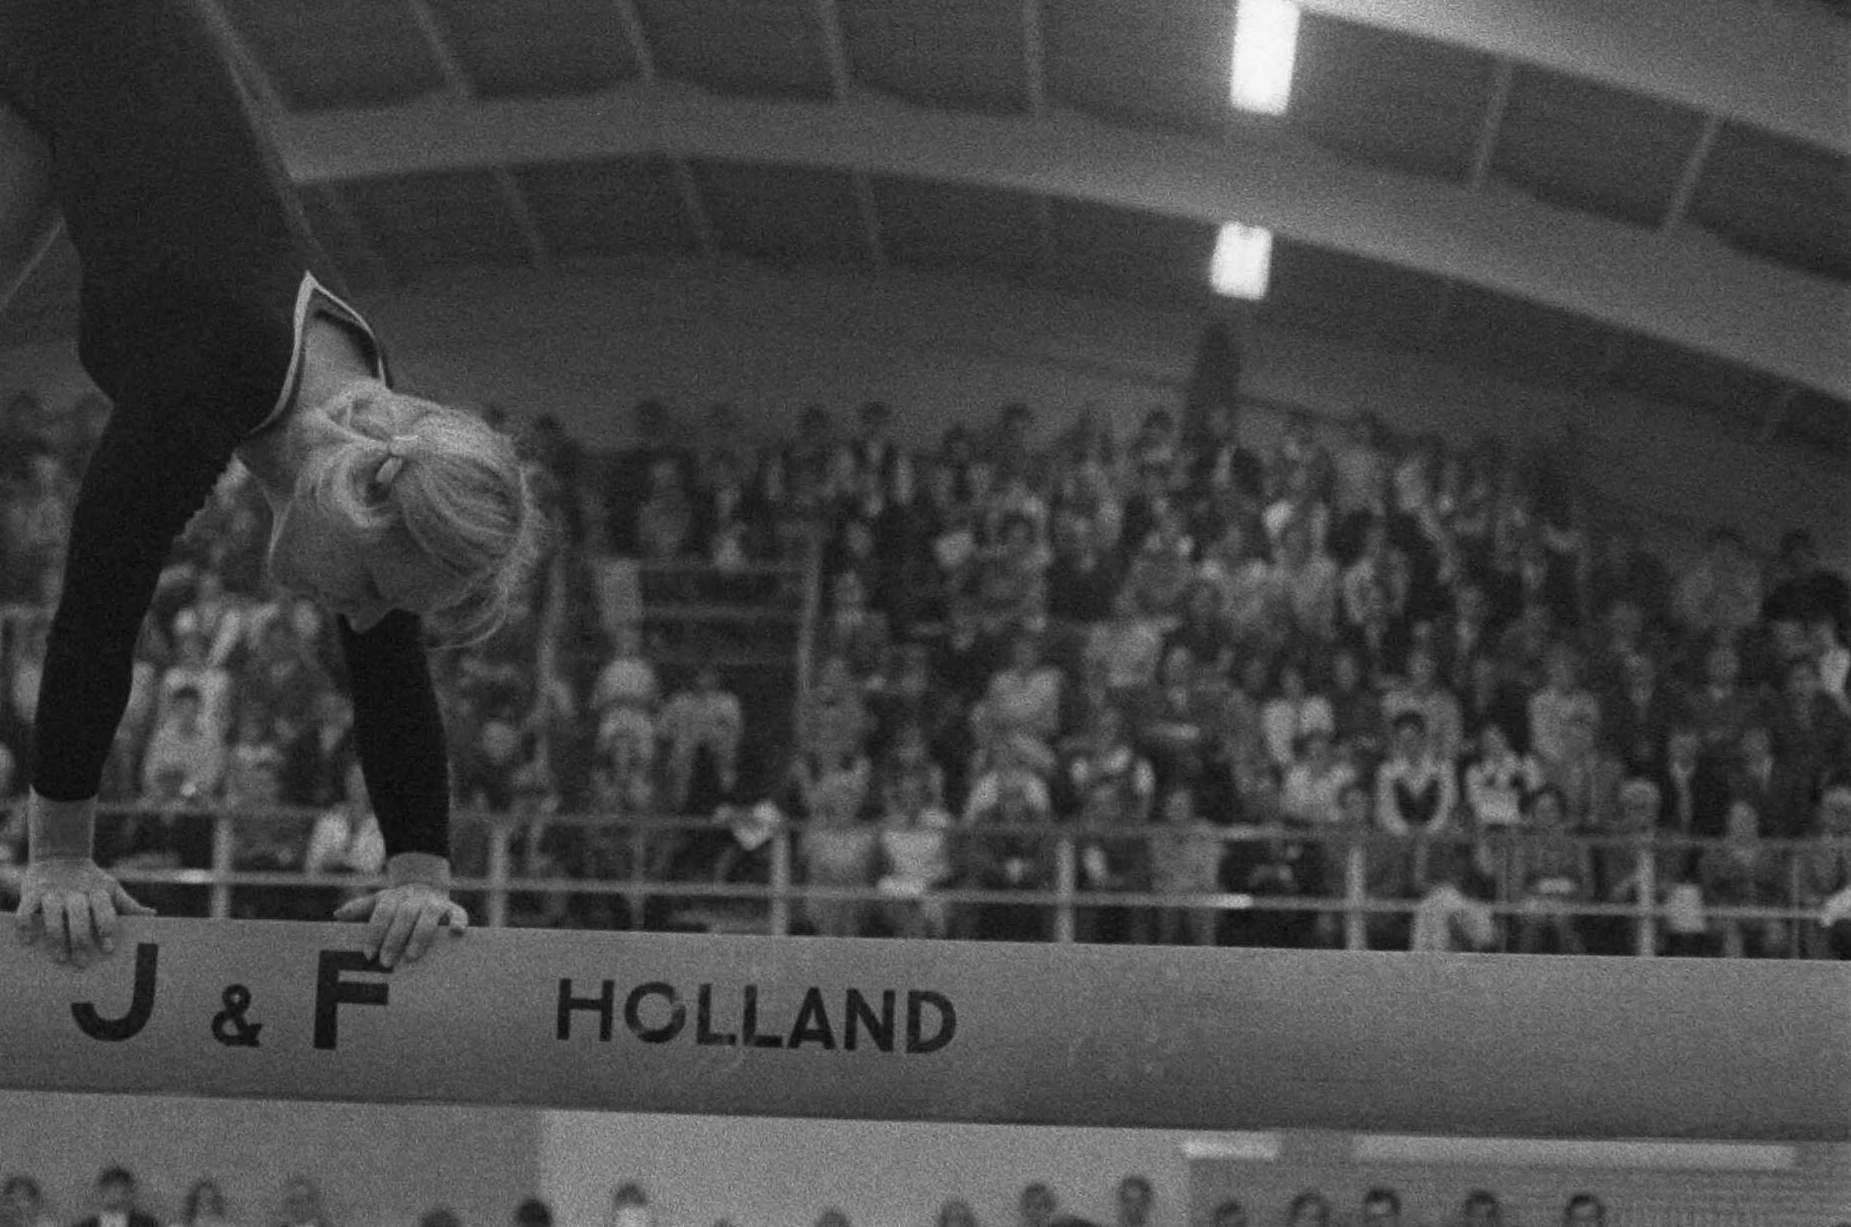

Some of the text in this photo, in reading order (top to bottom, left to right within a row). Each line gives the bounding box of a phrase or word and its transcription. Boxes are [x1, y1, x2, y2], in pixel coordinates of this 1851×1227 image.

[70, 943, 957, 1054] J & F HOLLAND
